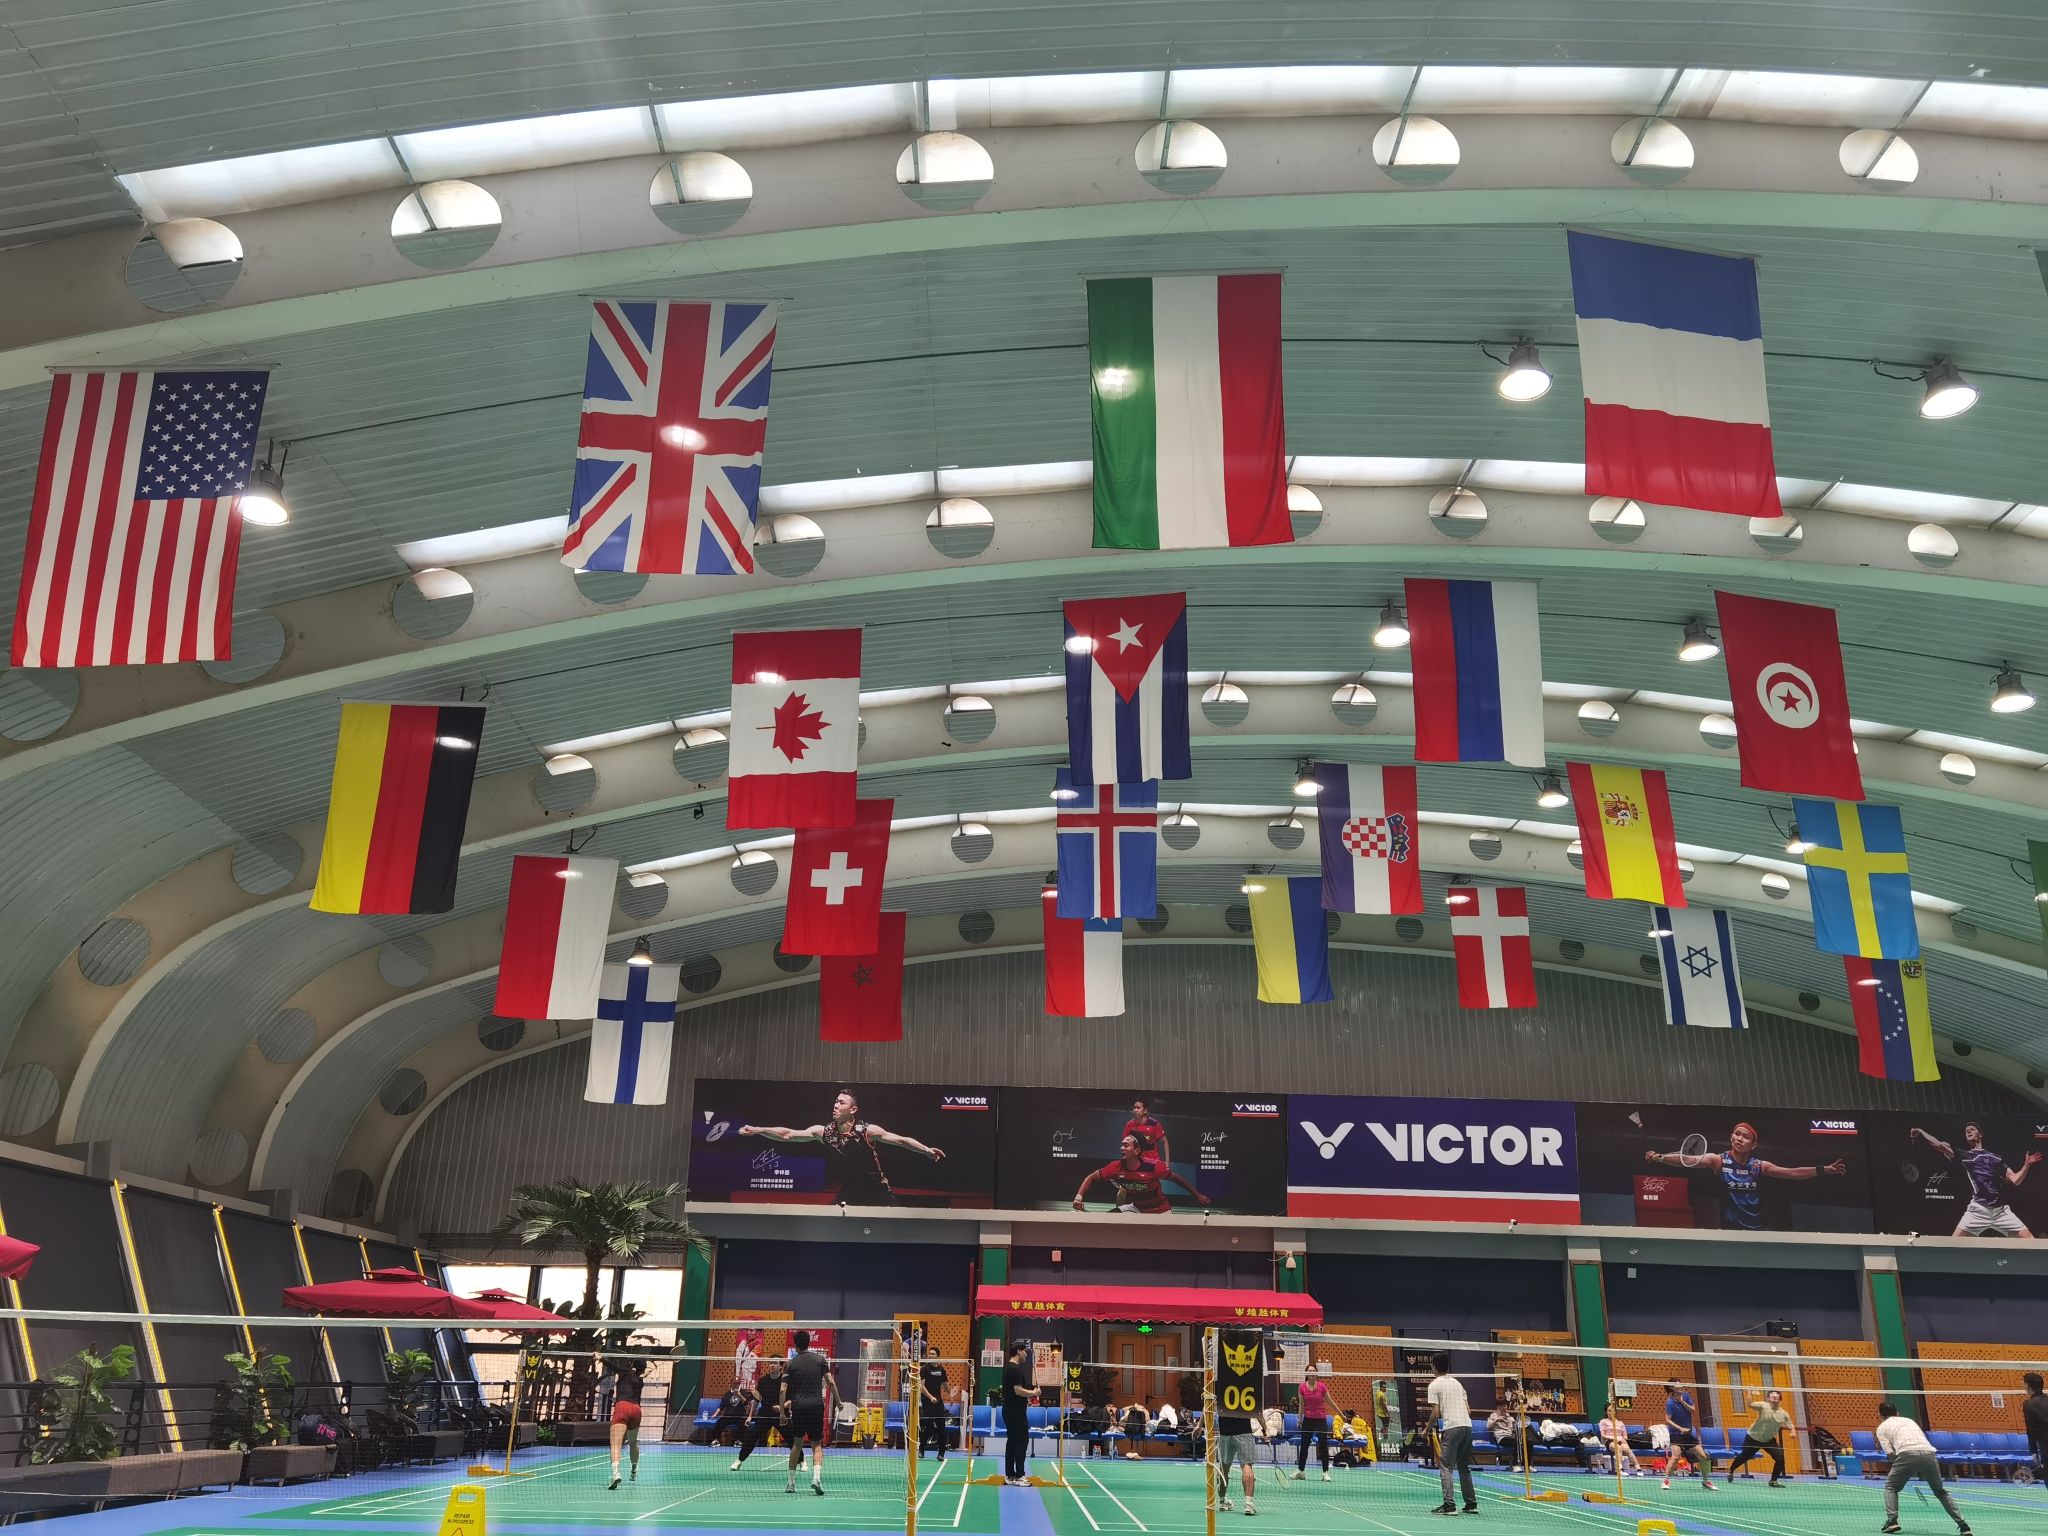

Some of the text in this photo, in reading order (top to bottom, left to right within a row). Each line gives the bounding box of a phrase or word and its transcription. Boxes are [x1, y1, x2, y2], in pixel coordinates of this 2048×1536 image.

[955, 1096, 987, 1105] VICTOR
[1245, 1103, 1278, 1112] VICTOR
[1822, 1120, 1856, 1129] VICTOR
[1365, 1122, 1564, 1167] VICTOR
[525, 1369, 537, 1379] V1
[1069, 1381, 1080, 1391] 03
[1224, 1385, 1256, 1412] 06
[1618, 1398, 1630, 1408] 04
